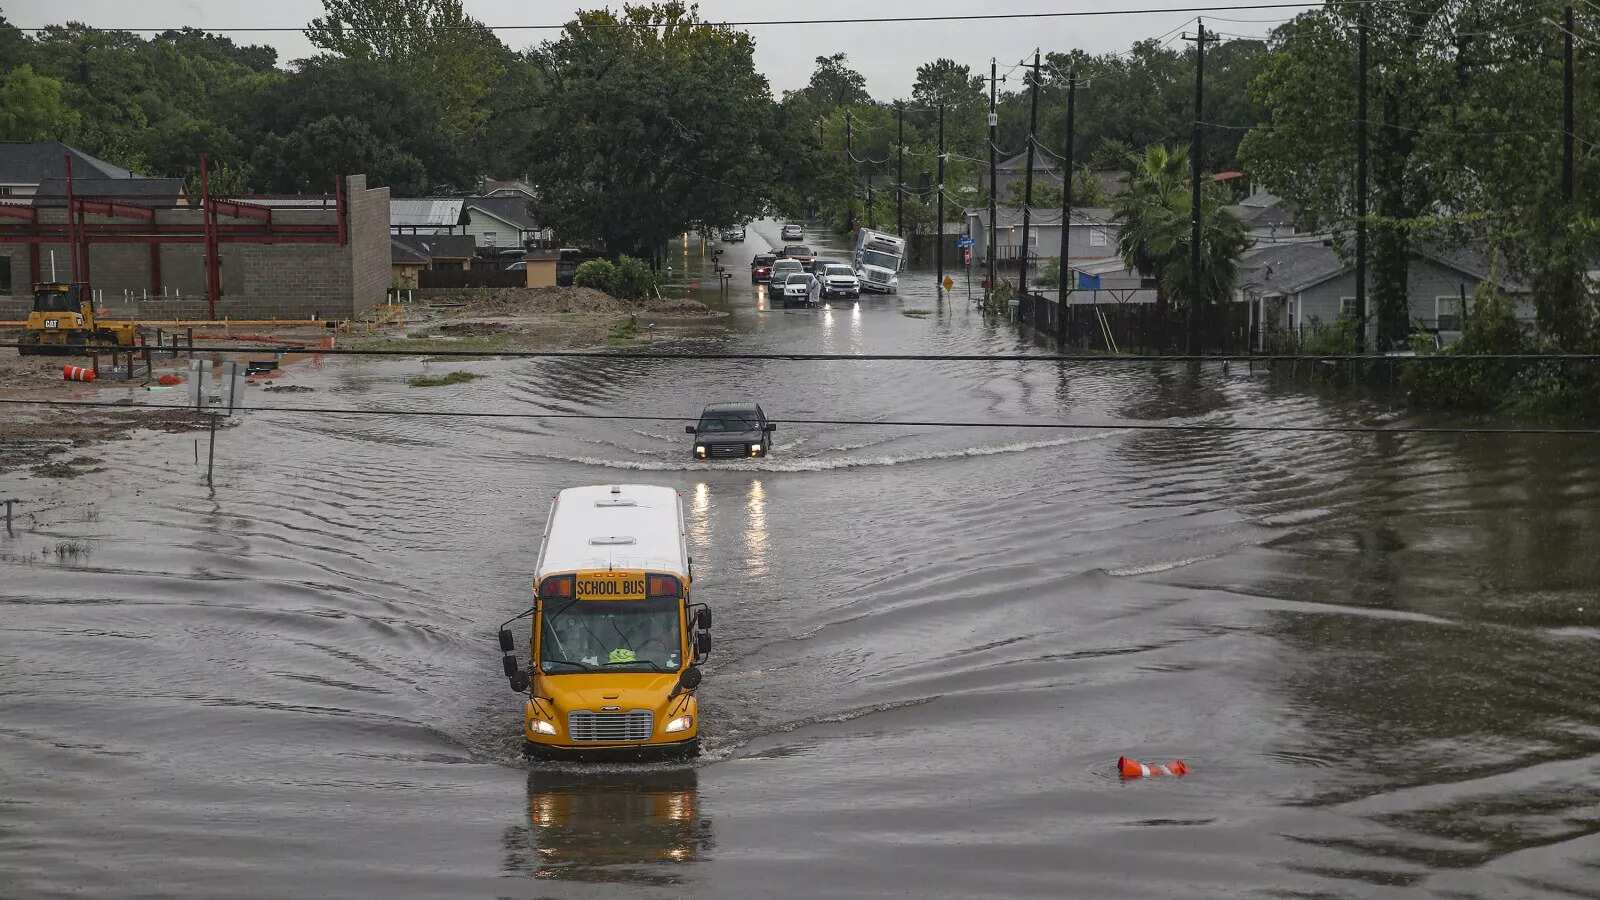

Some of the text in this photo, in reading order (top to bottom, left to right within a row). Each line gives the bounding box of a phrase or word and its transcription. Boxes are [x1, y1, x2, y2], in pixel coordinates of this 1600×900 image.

[45, 320, 58, 328] CAT
[577, 580, 645, 595] SCHOOL BUS
